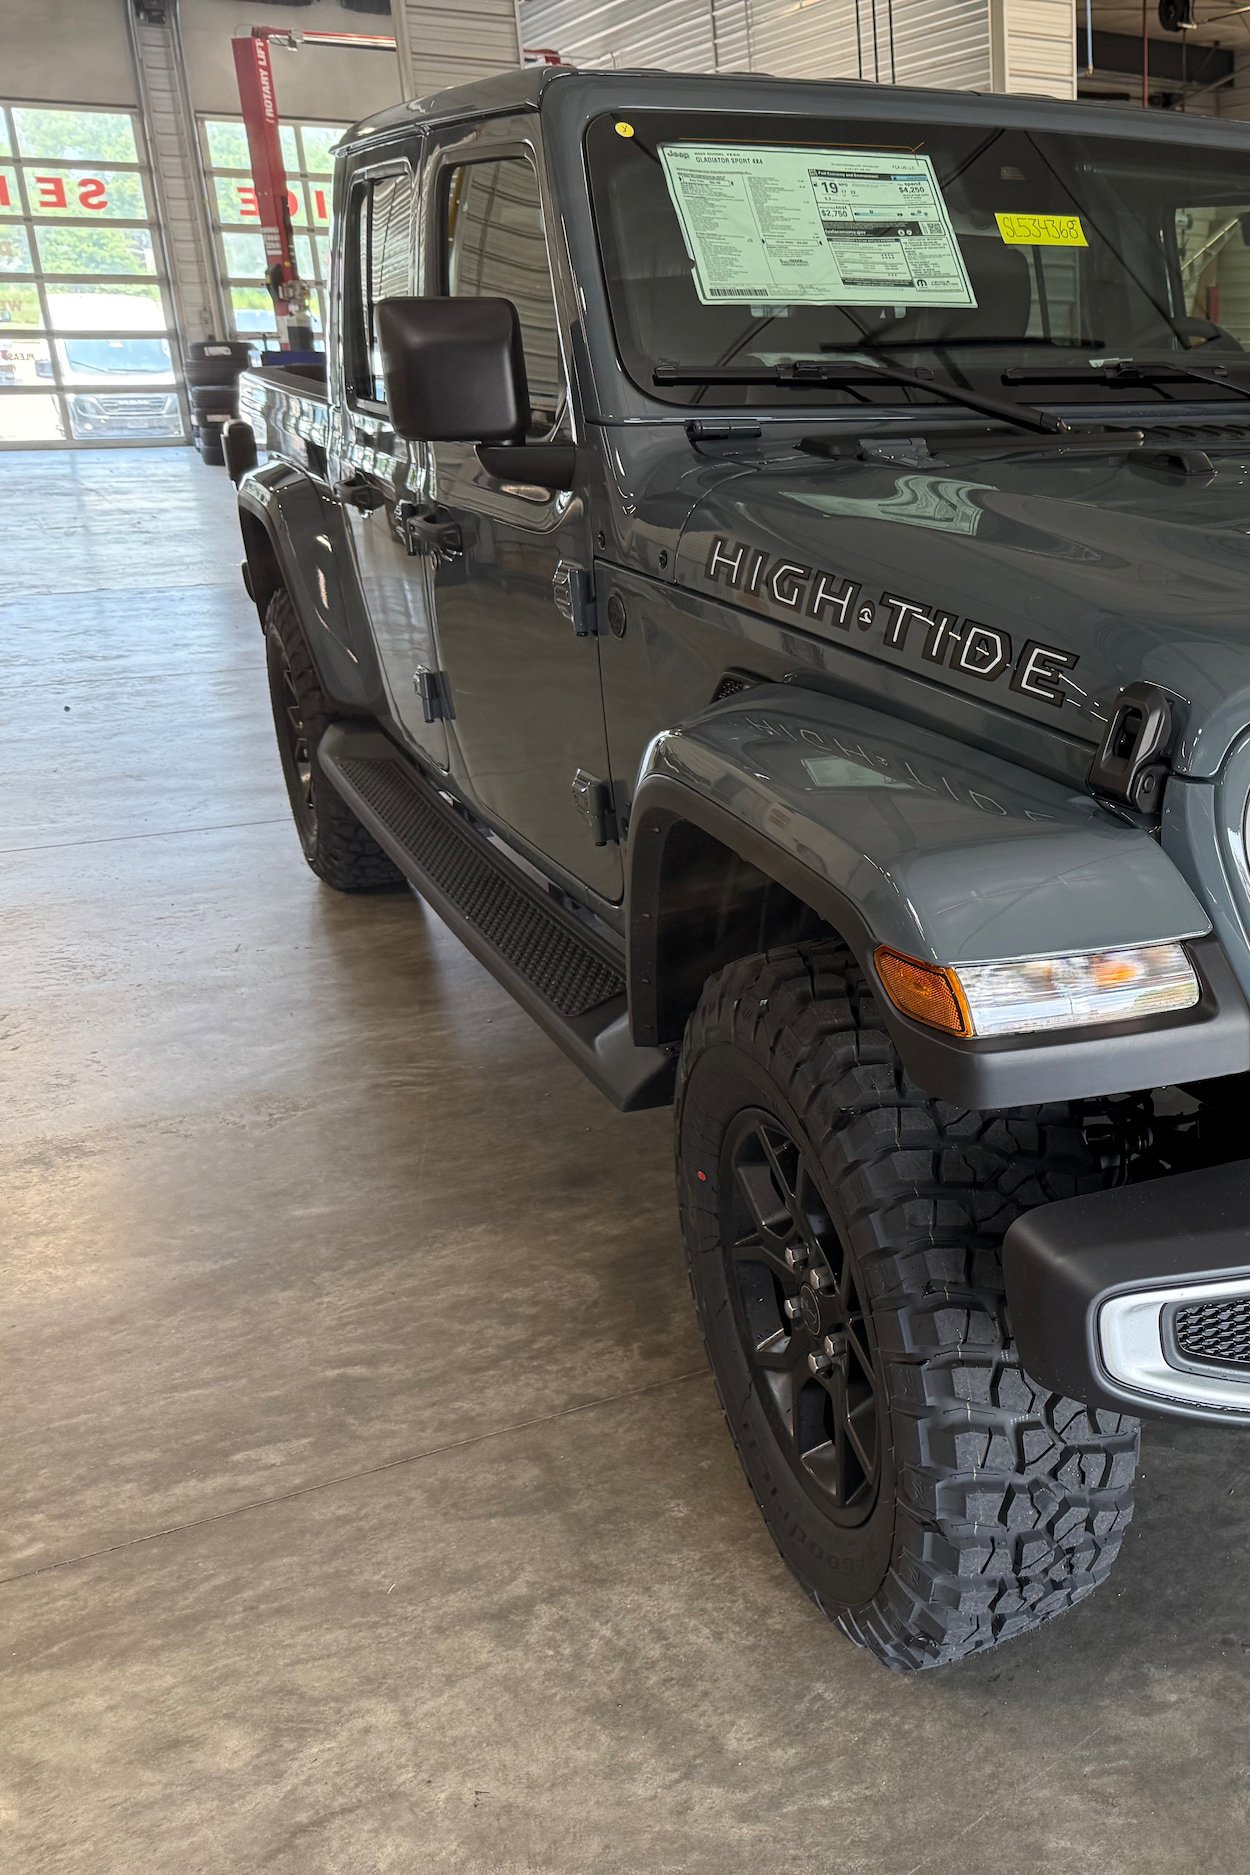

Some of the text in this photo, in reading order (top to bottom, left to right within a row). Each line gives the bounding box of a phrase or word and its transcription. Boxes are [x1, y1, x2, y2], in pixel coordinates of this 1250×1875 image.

[259, 70, 274, 117] ROTARY
[821, 181, 838, 194] 19
[898, 186, 925, 194] $4,250
[821, 210, 848, 218] $2,750
[704, 535, 1081, 708] HIGH TIDE
